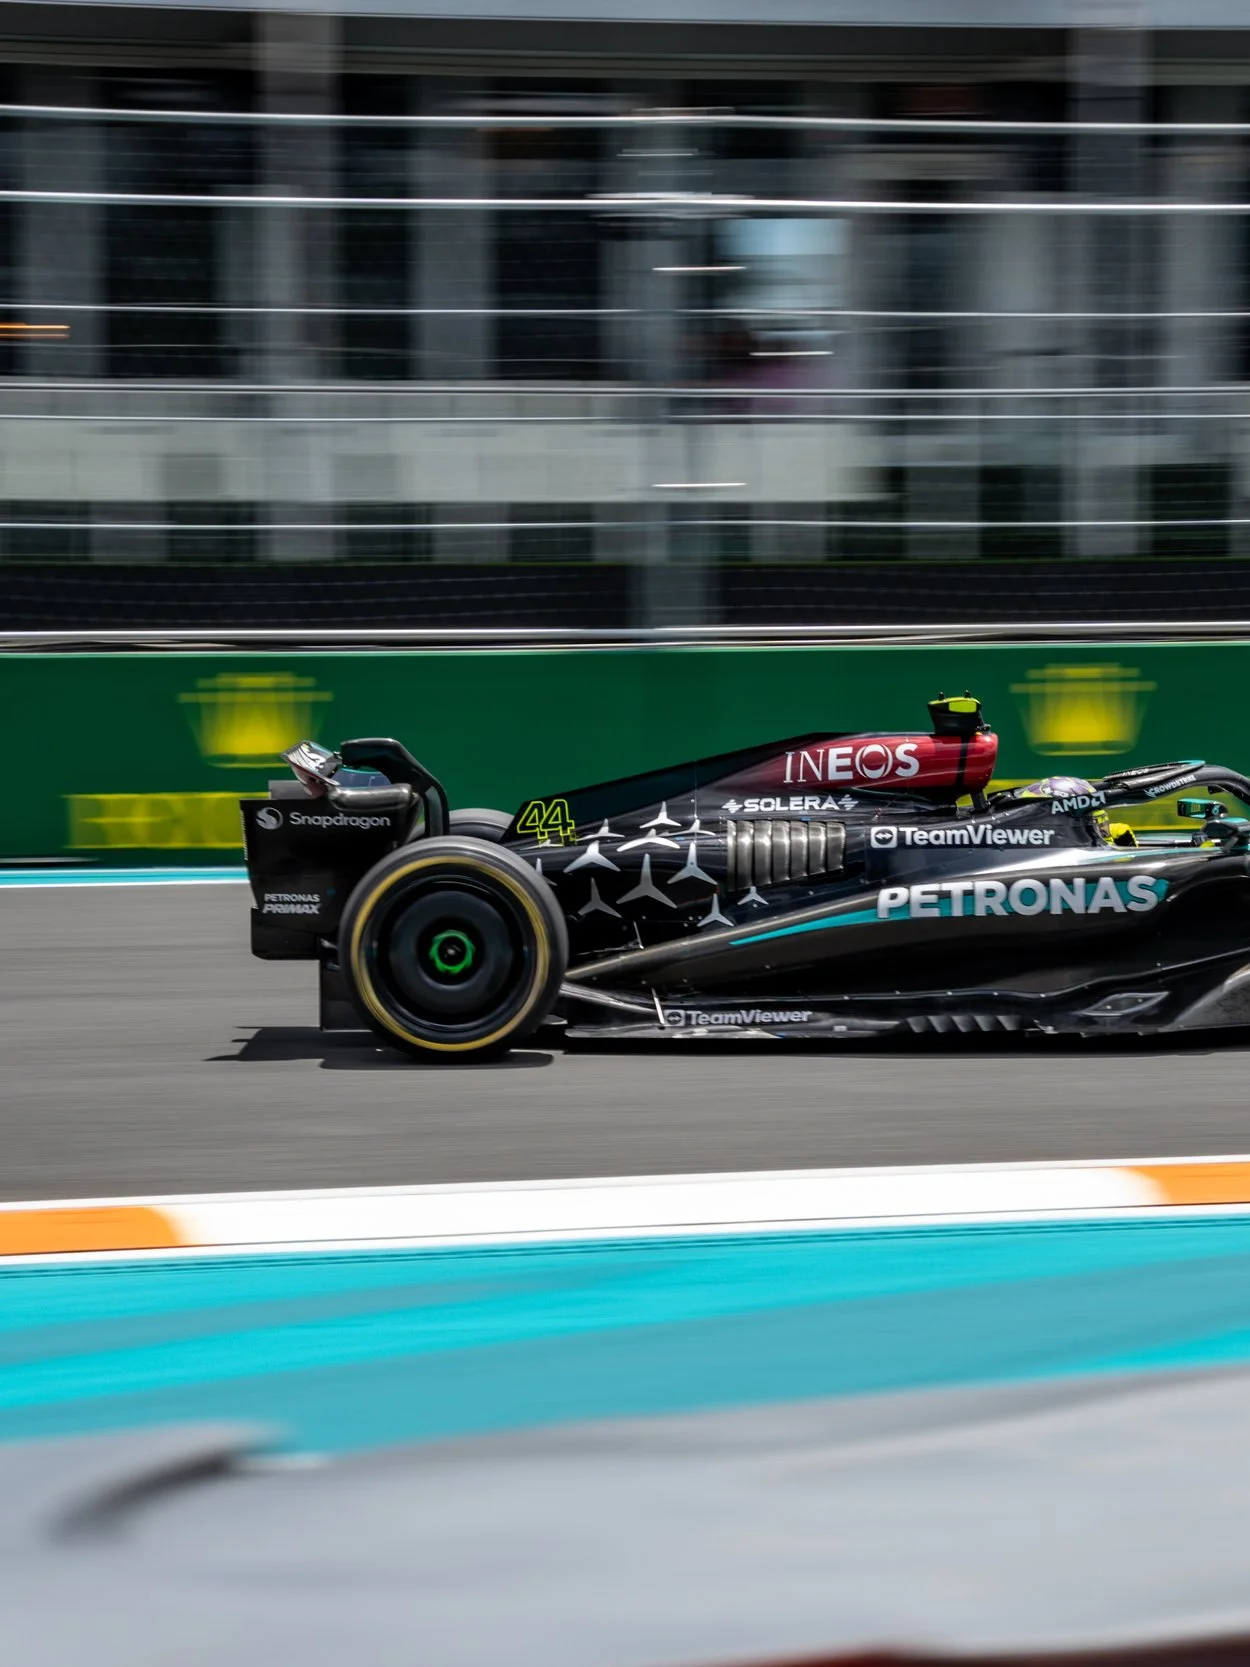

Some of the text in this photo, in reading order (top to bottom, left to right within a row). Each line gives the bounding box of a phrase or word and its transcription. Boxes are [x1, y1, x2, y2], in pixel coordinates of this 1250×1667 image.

[783, 743, 921, 784] INEOS
[743, 795, 840, 813] SOLERA
[1051, 795, 1091, 815] AMD
[289, 811, 391, 830] Snapdragon
[516, 799, 576, 840] 44
[899, 824, 1056, 846] TeamViewer
[264, 893, 321, 902] PETRONAS
[877, 875, 1160, 919] PETRONAS
[262, 903, 323, 914] PRIMAX
[690, 1010, 812, 1025] TeamViewer
